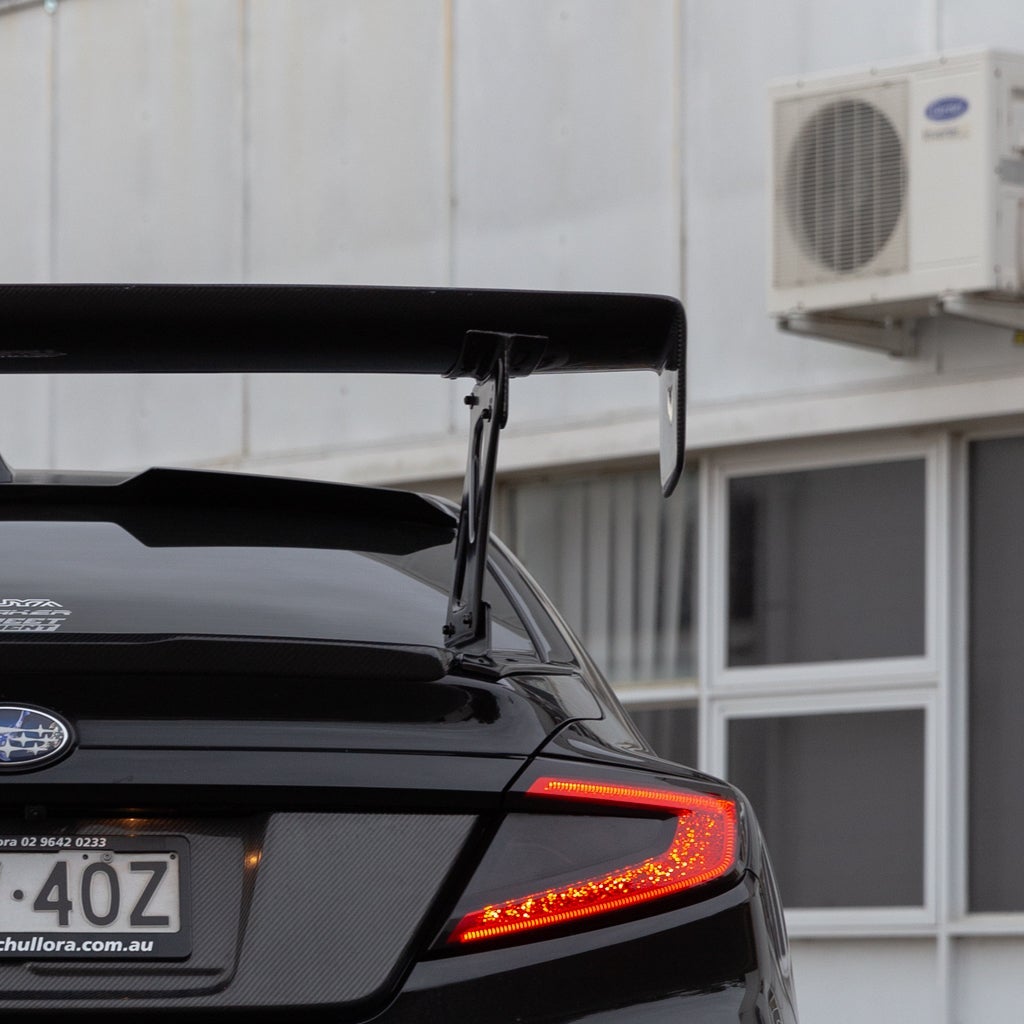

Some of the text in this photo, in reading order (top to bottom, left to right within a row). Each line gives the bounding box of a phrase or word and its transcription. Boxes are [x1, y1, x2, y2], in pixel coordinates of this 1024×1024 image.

[20, 837, 37, 847] 02
[39, 837, 72, 847] 9642
[75, 837, 107, 847] 0233
